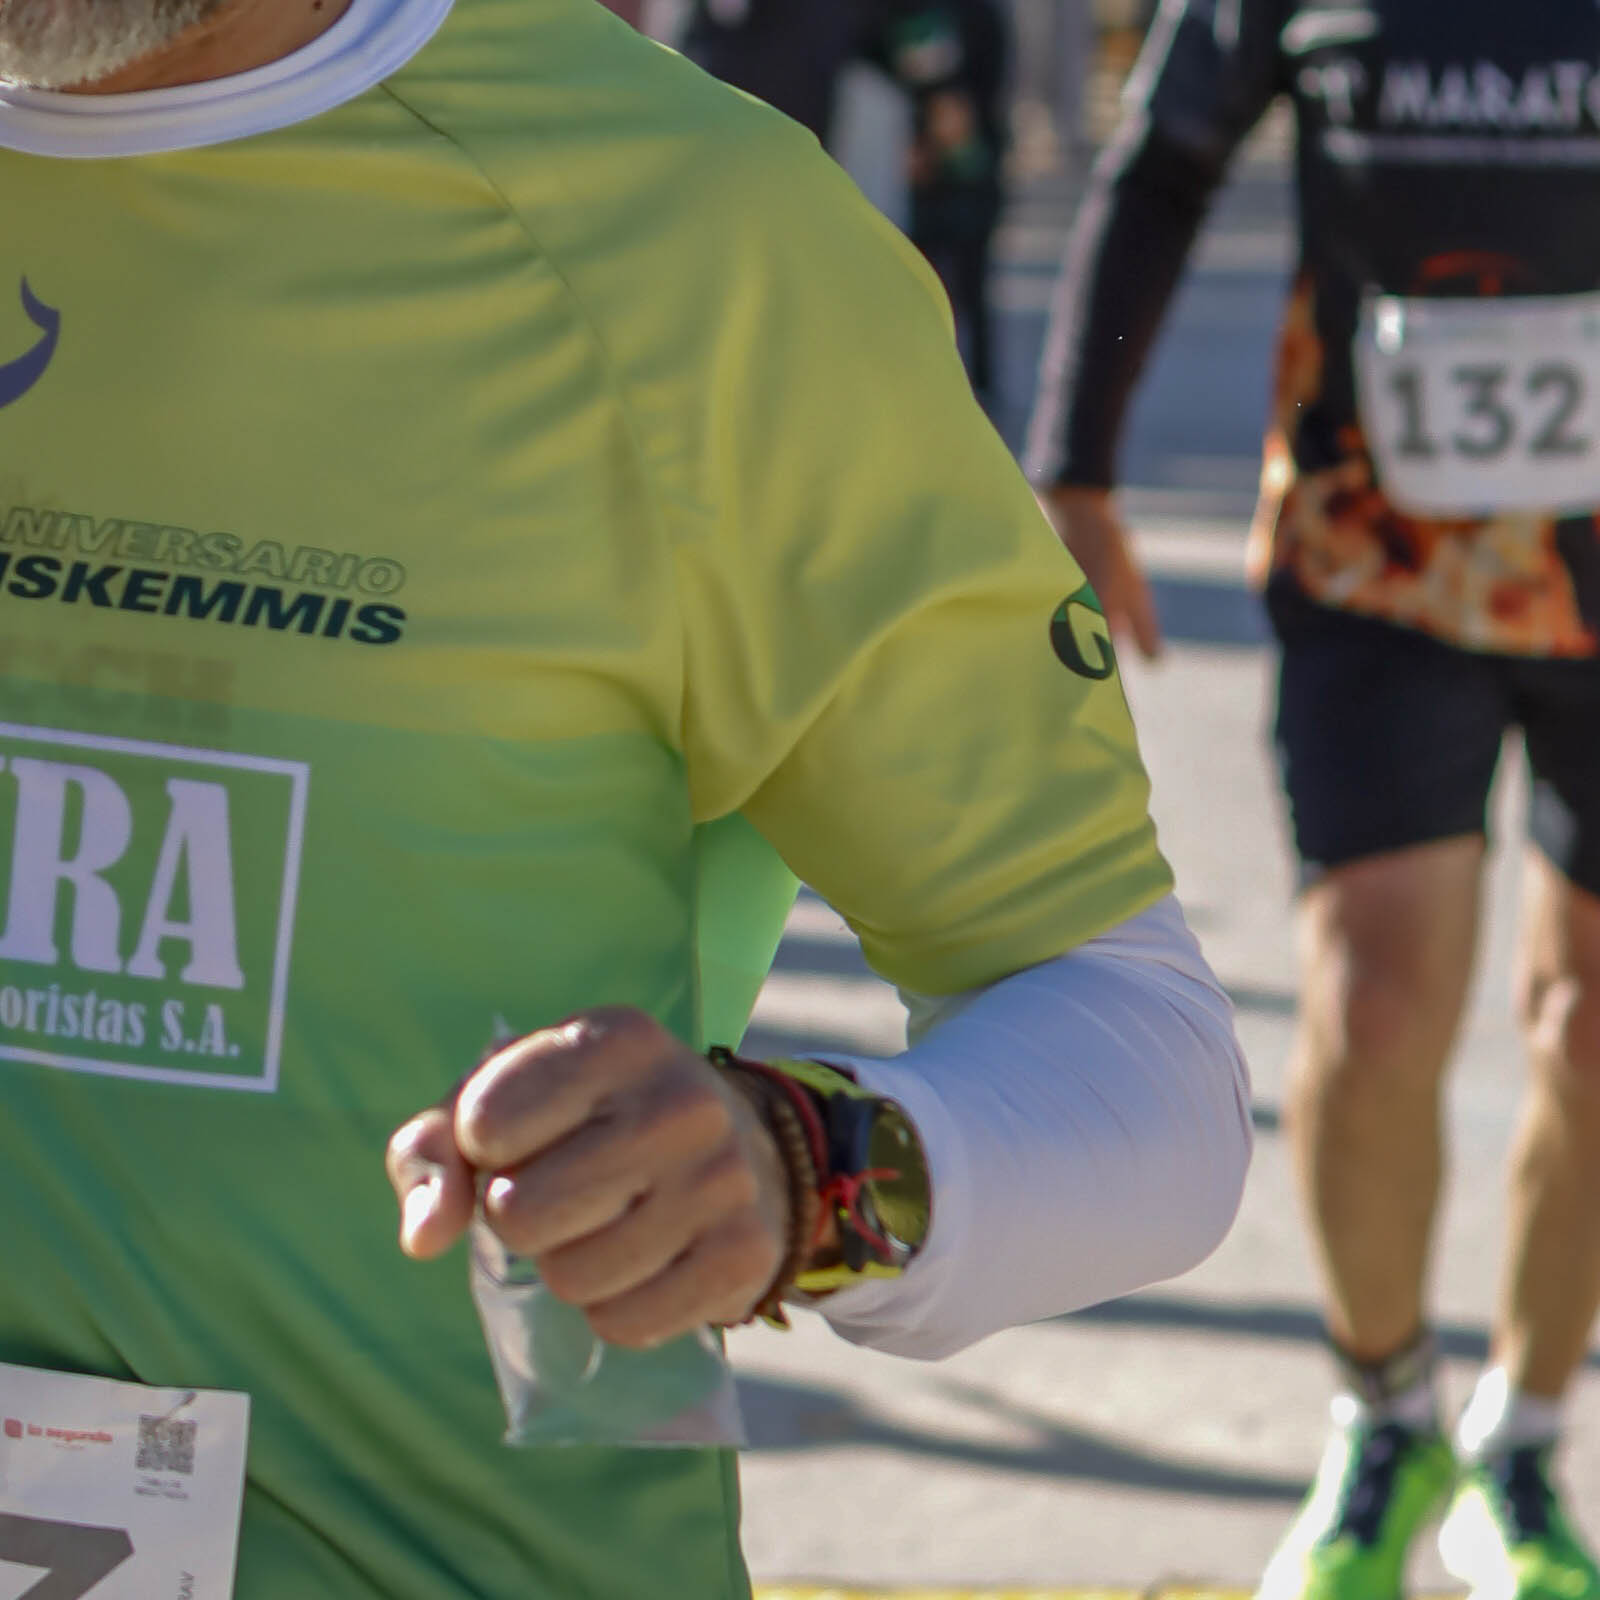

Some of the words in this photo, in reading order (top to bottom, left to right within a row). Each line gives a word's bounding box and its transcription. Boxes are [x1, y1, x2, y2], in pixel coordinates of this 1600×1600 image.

[1377, 56, 1599, 129] MARAT
[1386, 357, 1594, 465] 132
[160, 998, 242, 1057] S.A.
